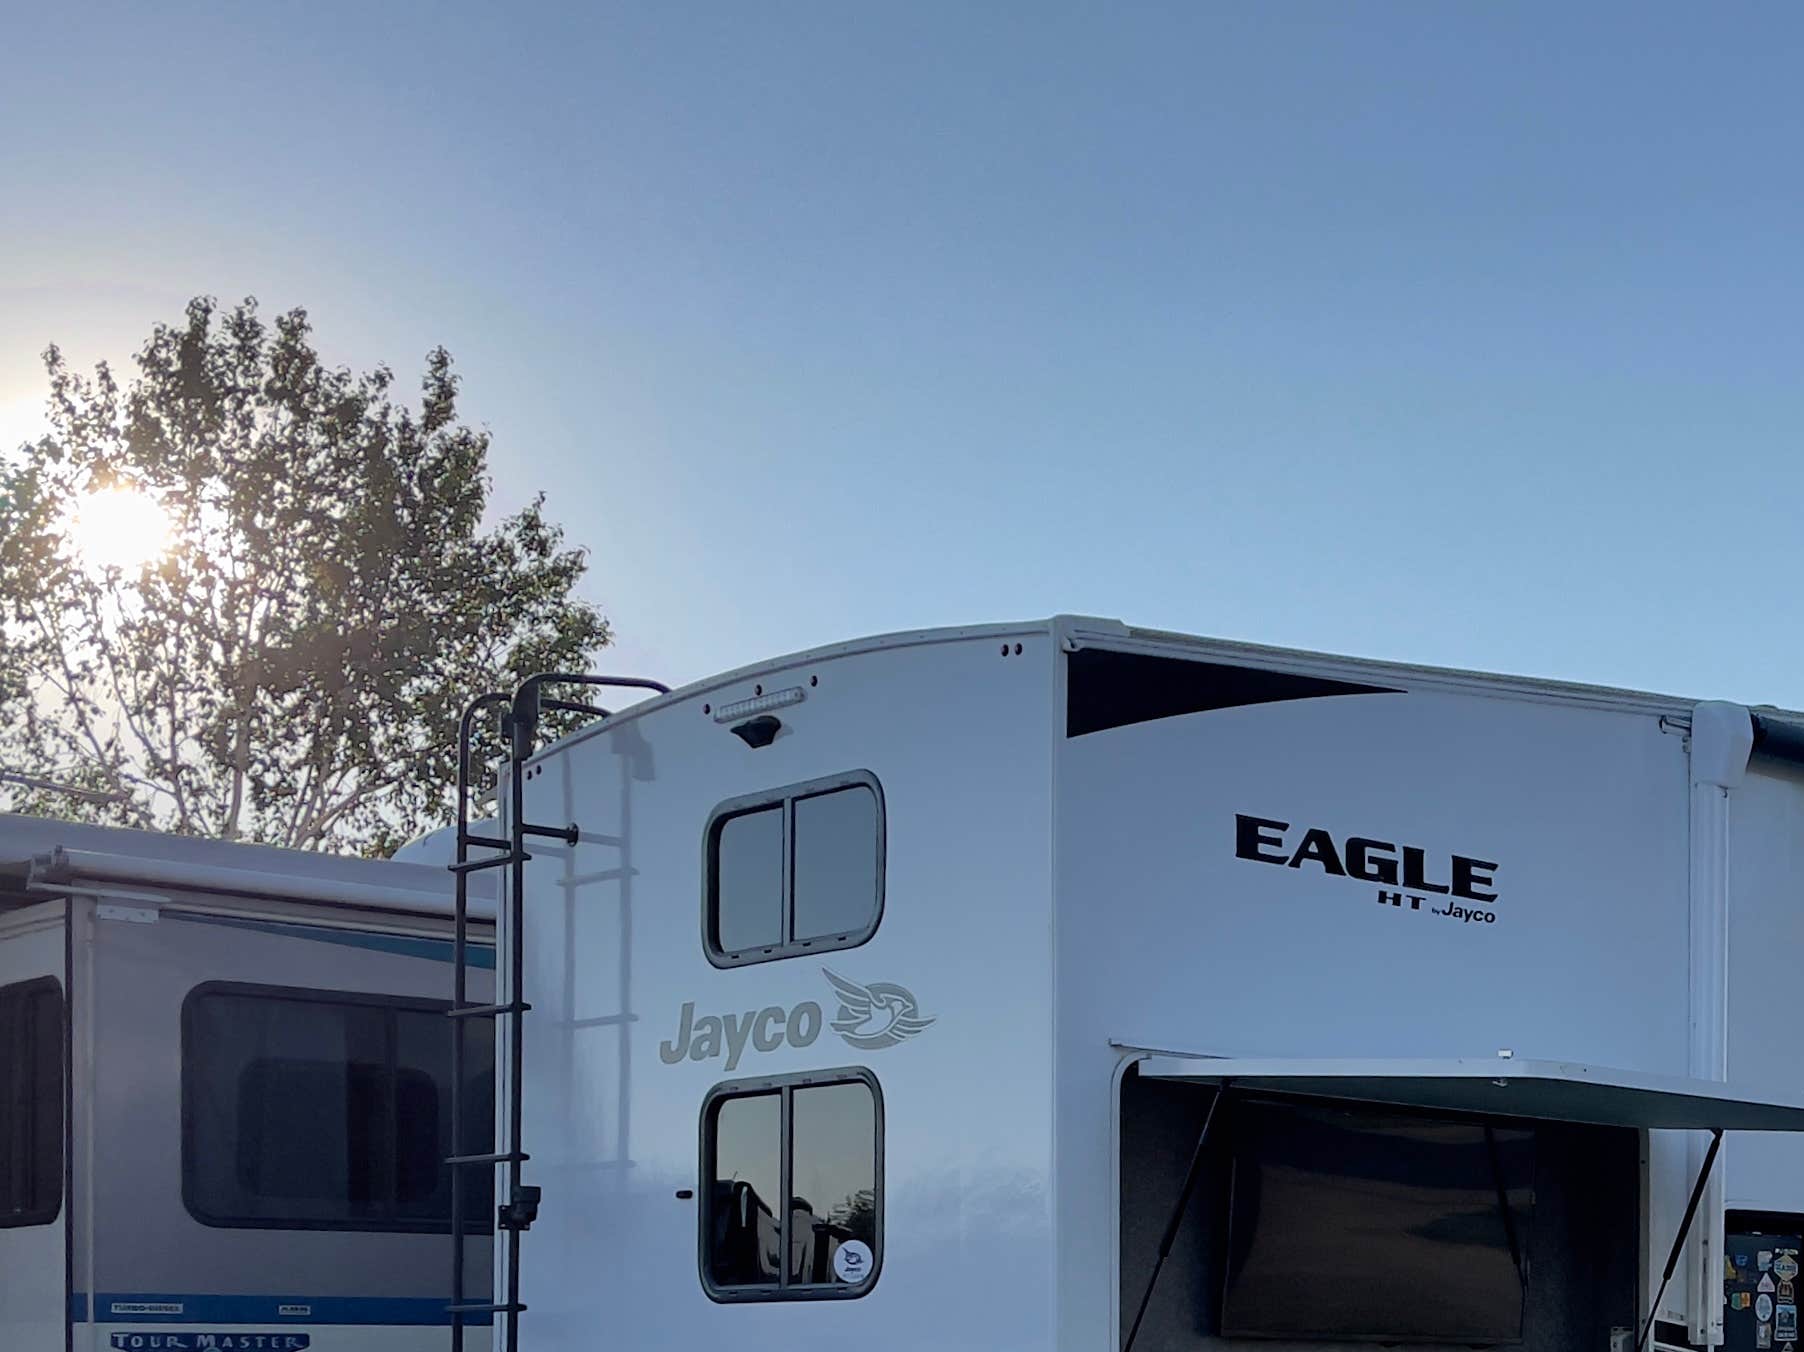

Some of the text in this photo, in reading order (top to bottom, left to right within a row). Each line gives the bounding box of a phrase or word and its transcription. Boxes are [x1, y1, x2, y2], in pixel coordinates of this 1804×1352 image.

[1235, 813, 1499, 903] EAGLE
[1378, 890, 1427, 910] HT
[1442, 901, 1496, 923] Jayco
[659, 1001, 823, 1072] Jayco
[112, 1332, 309, 1350] TOUR MASTER
